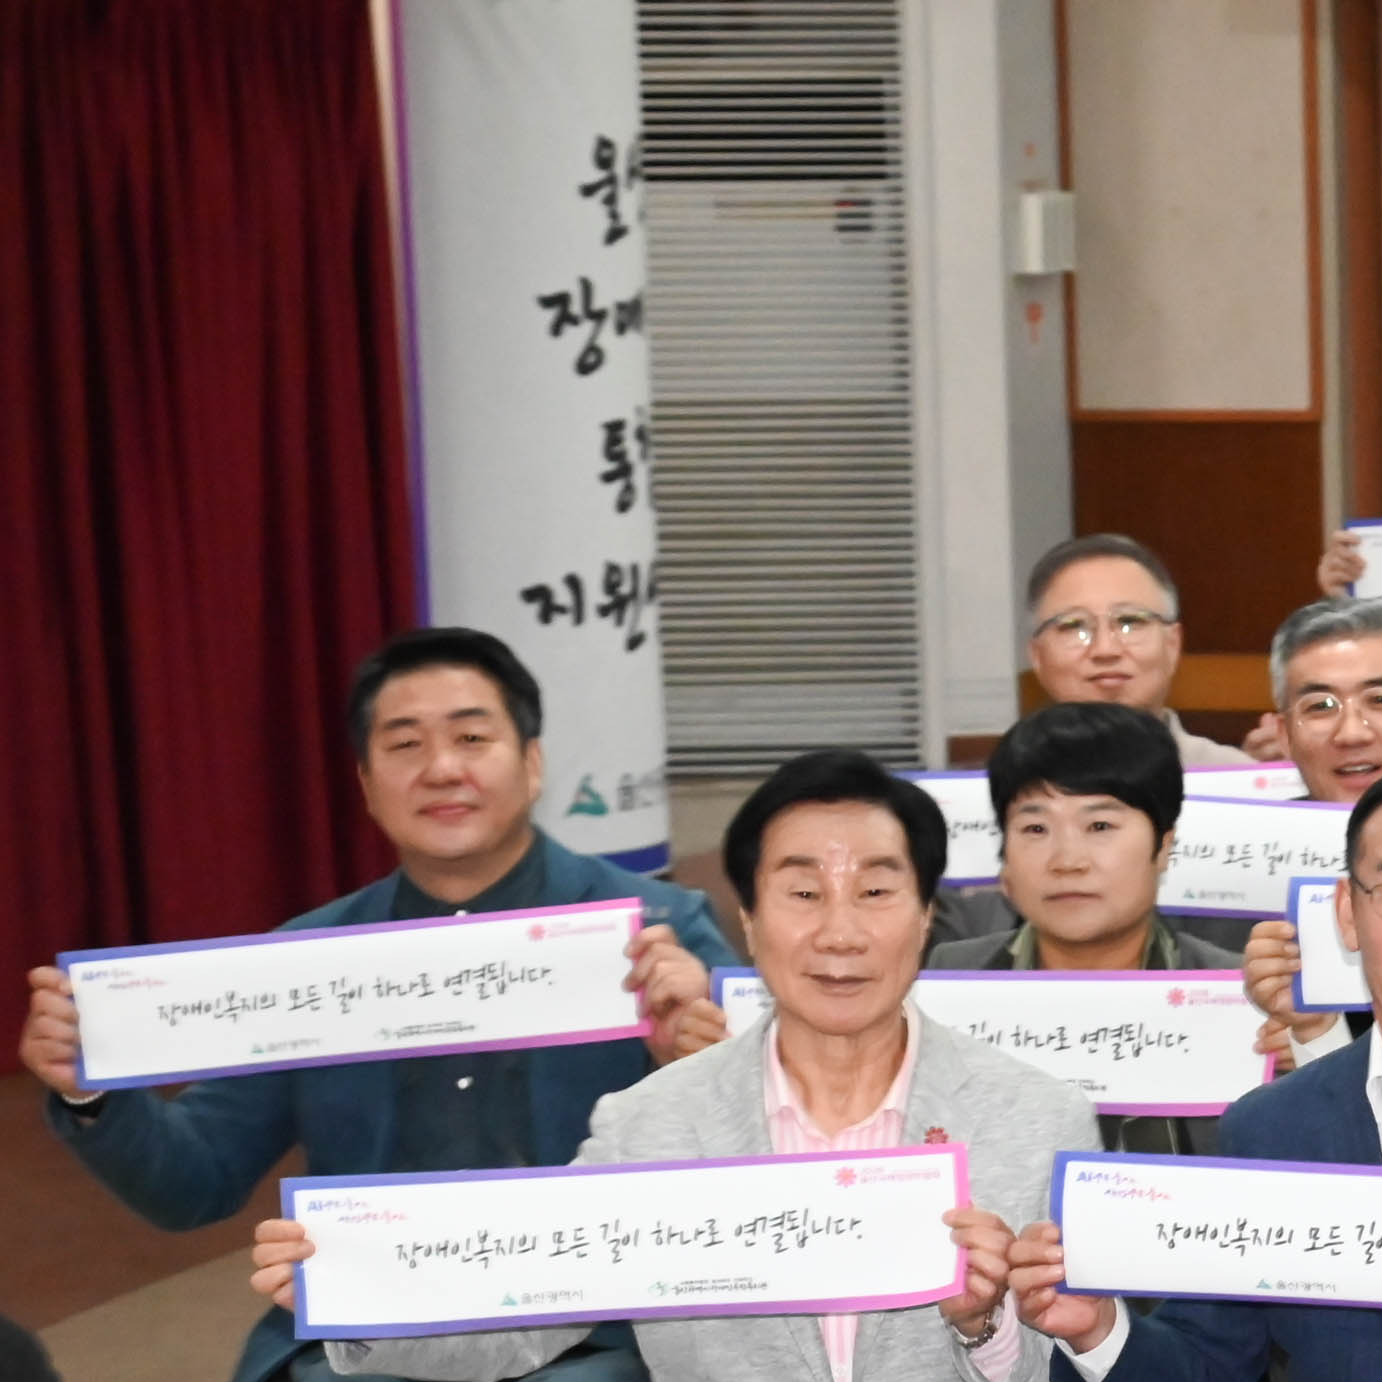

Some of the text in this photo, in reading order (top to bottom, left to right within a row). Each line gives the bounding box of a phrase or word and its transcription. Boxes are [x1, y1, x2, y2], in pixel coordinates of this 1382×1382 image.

[1010, 1024, 1072, 1052] 하나로
[1079, 1022, 1189, 1062] 연결됩니다.
[395, 1207, 863, 1270] 장애인복지의 모든 길이 하나로 연결됩니다.
[1156, 1217, 1295, 1257] 장애인복지의
[1303, 1225, 1345, 1257] 모든
